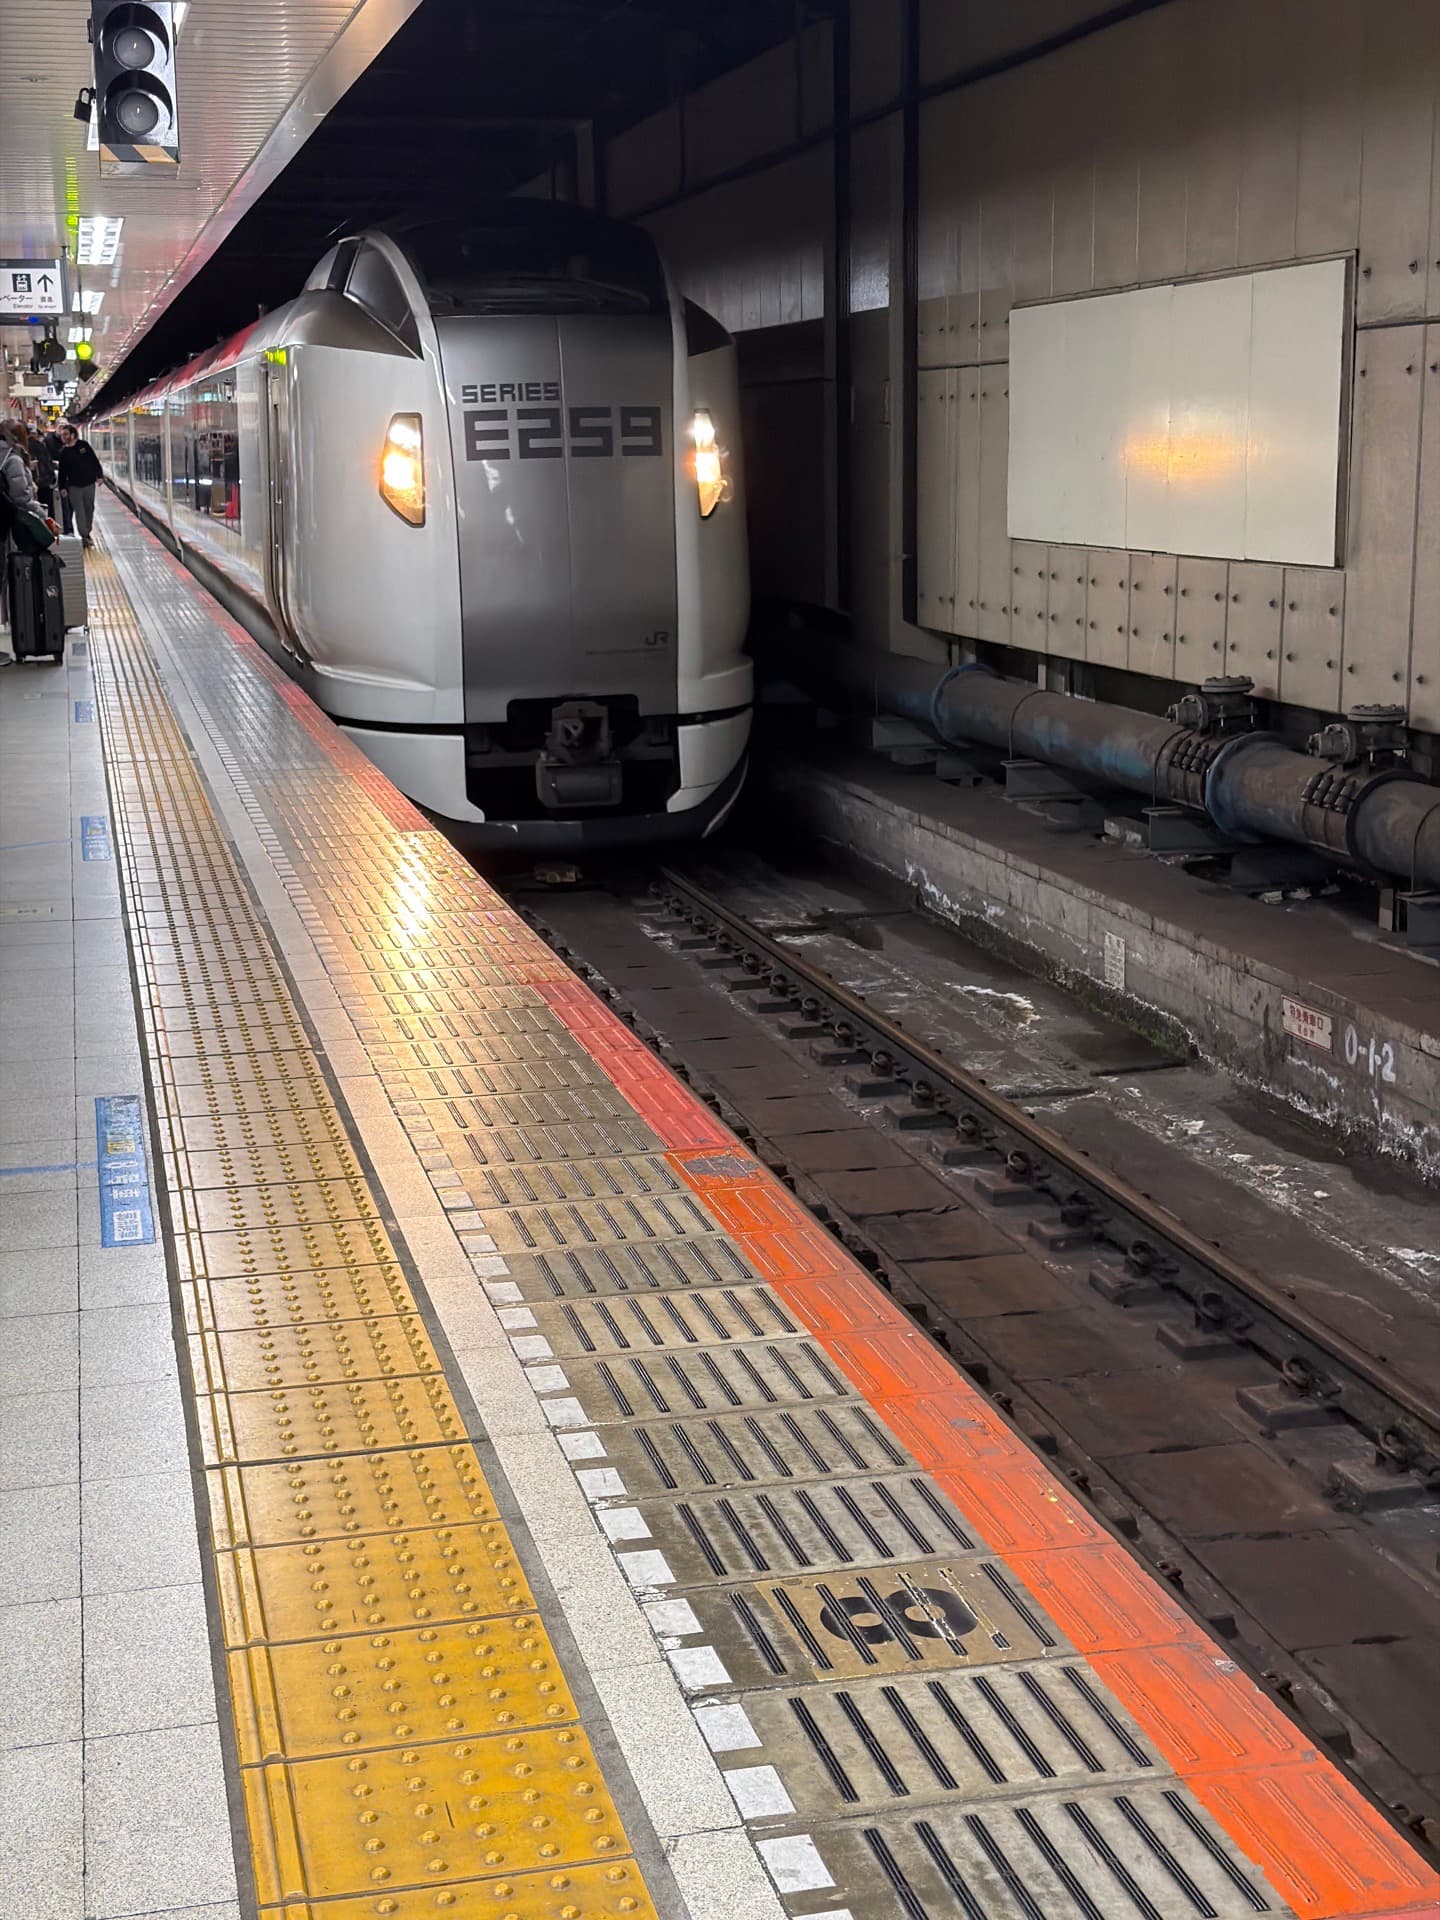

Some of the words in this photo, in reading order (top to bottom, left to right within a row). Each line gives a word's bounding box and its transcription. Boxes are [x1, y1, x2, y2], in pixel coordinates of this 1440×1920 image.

[0, 294, 32, 303] ベーター
[462, 382, 561, 404] SERIES
[463, 406, 663, 461] E259
[645, 631, 669, 646] JR
